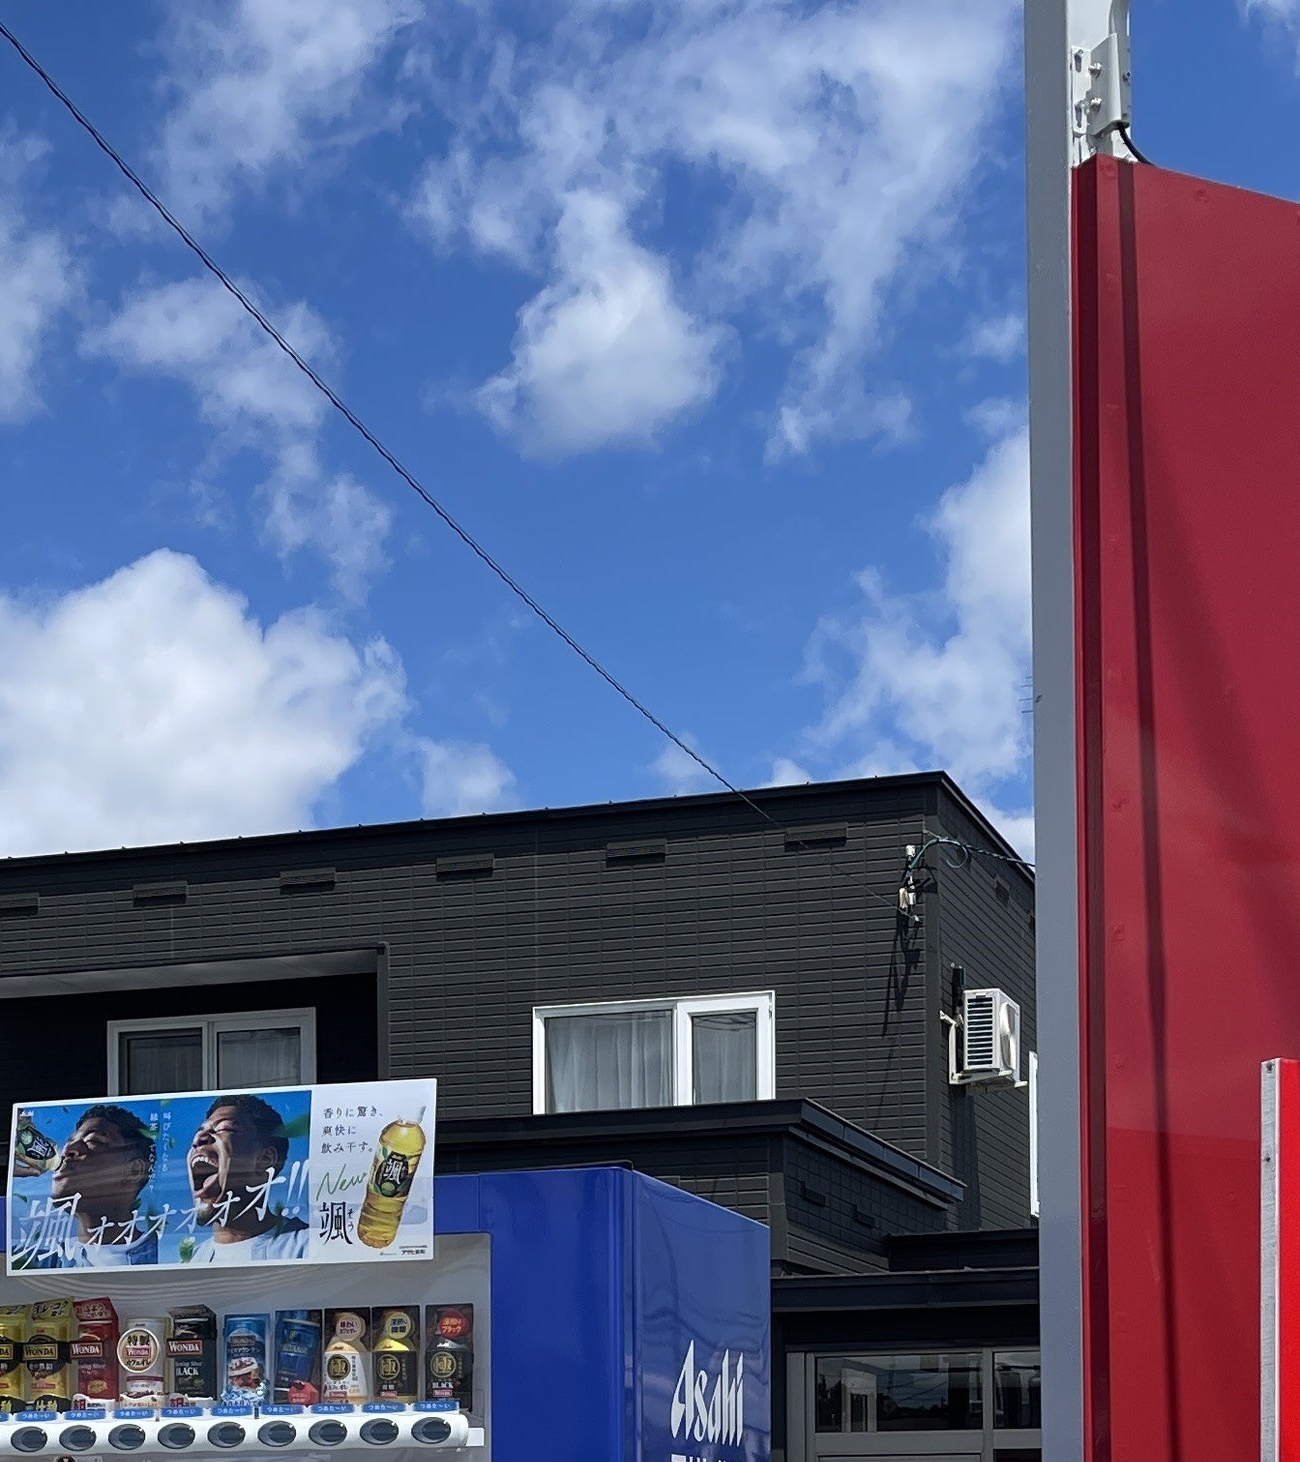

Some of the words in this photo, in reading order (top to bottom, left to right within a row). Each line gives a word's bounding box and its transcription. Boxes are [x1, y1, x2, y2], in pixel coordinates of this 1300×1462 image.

[316, 1164, 367, 1202] New
[319, 1202, 353, 1245] 颯
[25, 1346, 54, 1356] WONDA
[71, 1343, 100, 1354] WONDA
[168, 1341, 200, 1353] WONDA
[670, 1339, 744, 1447] Asahi
